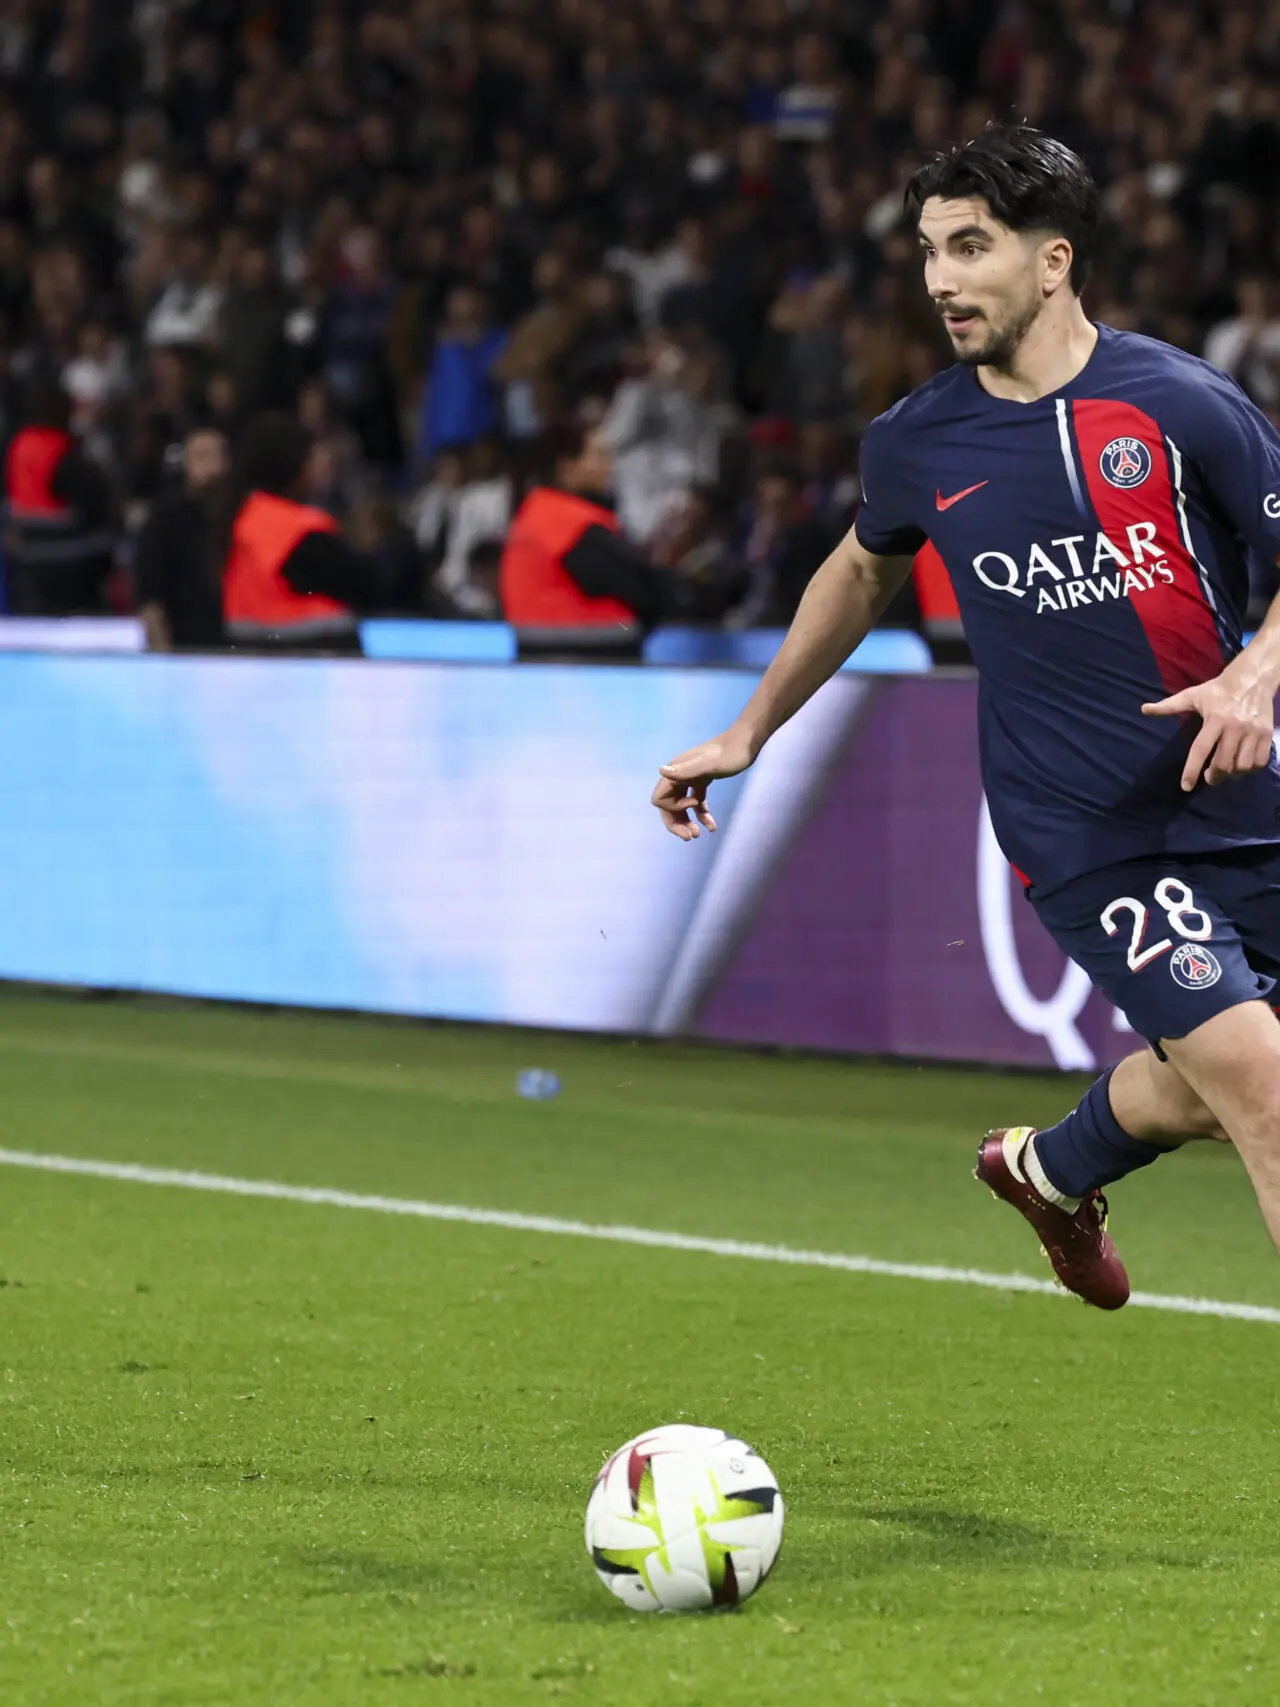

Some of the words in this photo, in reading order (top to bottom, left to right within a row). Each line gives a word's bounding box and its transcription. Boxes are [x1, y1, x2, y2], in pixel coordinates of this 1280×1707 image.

[1105, 440, 1138, 456] PARIS
[972, 521, 1166, 597] QATAR
[1036, 559, 1174, 614] AIRWAYS
[1100, 877, 1212, 973] 28
